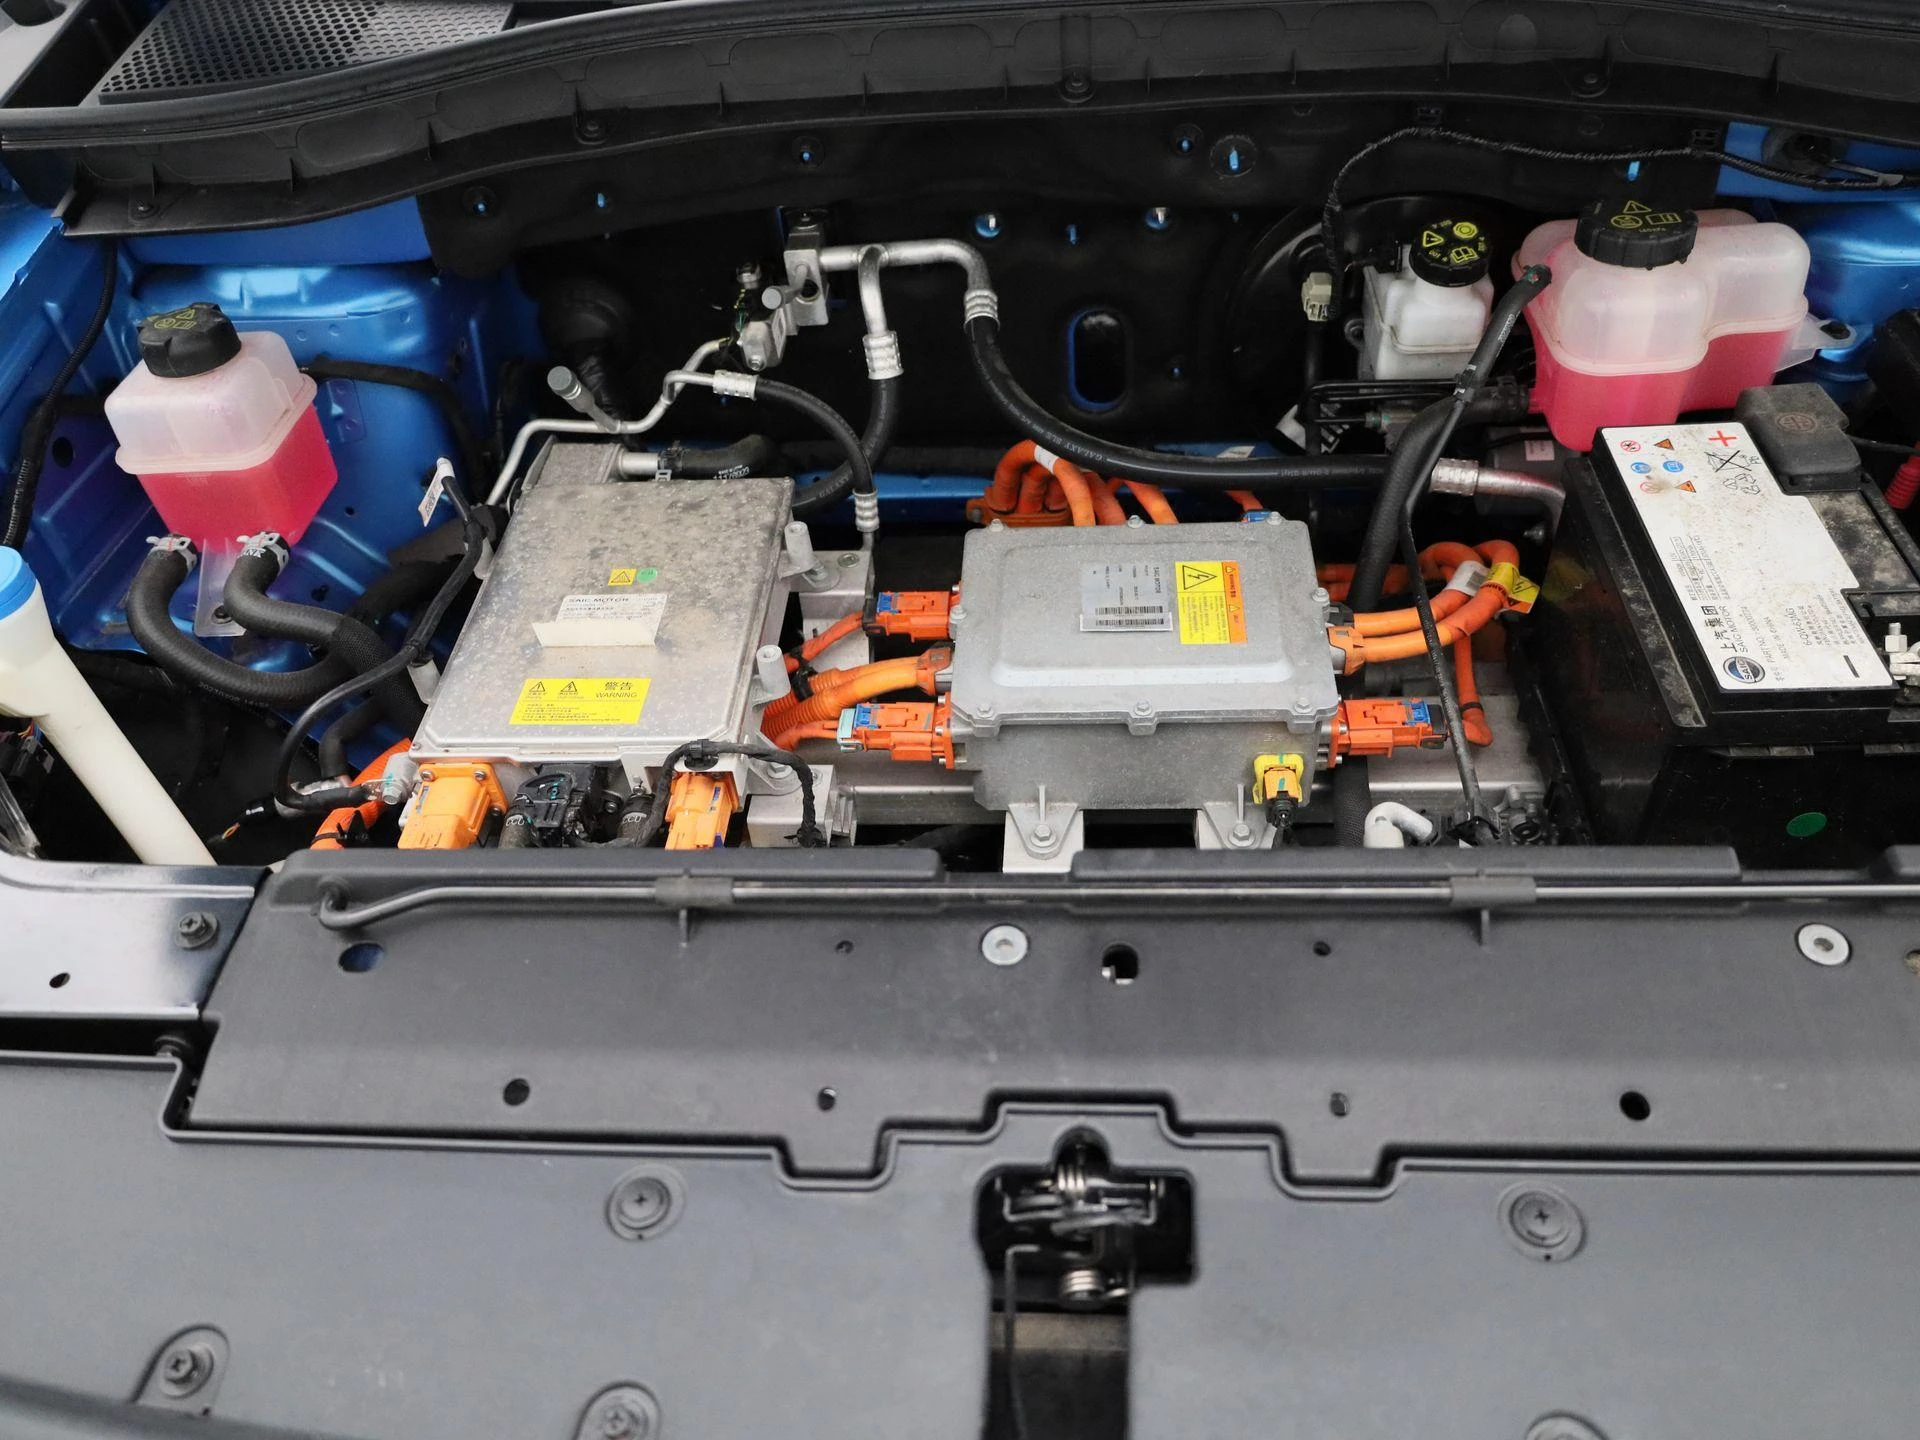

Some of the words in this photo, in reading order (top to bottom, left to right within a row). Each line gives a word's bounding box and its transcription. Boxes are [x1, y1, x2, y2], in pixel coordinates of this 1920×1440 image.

[1064, 441, 1103, 462] GALAXY
[1700, 605, 1737, 653] 上汽集团
[1718, 605, 1737, 633] MOTOR
[1732, 633, 1748, 653] SAIC
[1737, 658, 1752, 680] SAIC
